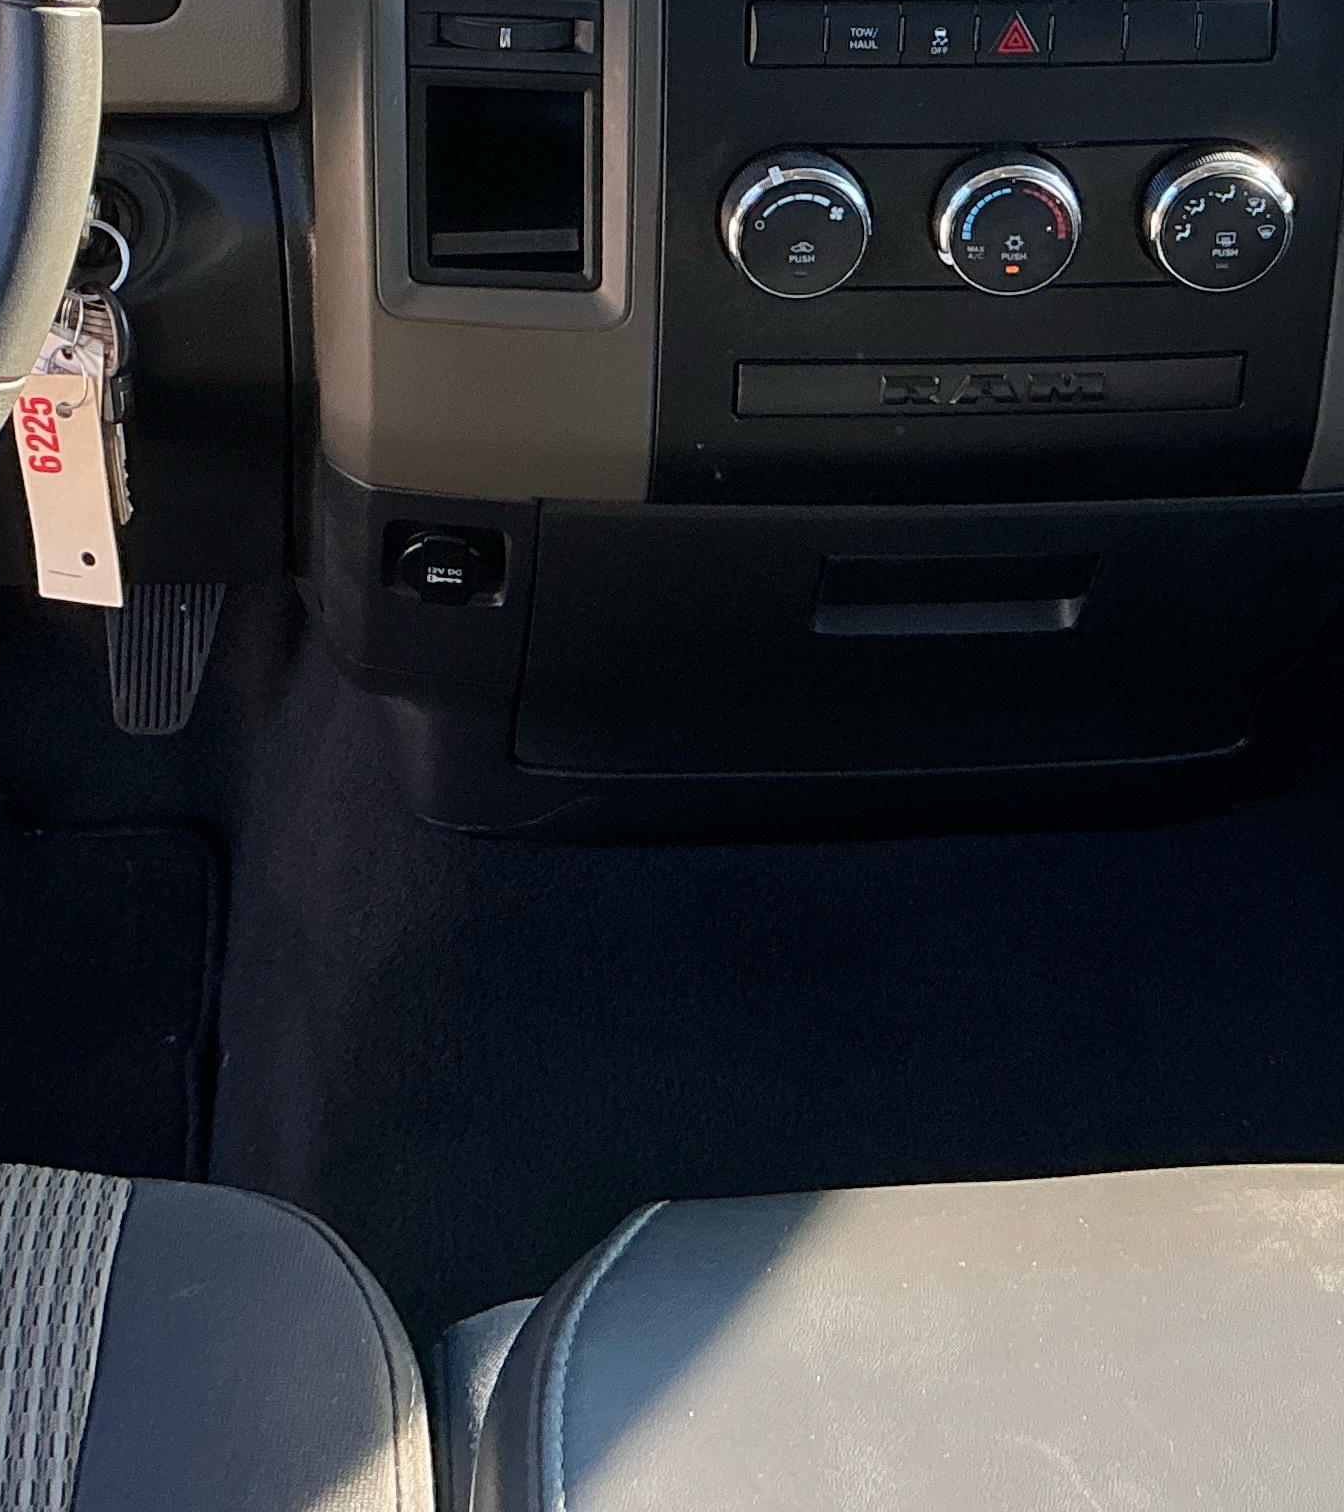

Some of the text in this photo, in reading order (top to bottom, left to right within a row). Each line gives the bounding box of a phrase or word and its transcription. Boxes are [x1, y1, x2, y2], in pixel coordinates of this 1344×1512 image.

[850, 27, 879, 38] TOW/
[849, 39, 878, 49] HAUL
[930, 46, 949, 55] OFF
[966, 245, 985, 253] MAX
[1211, 248, 1238, 258] PUSH
[788, 254, 815, 264] PUSH
[967, 252, 984, 261] A/C
[1000, 252, 1028, 262] PUSH
[879, 371, 1106, 406] RAM
[19, 396, 62, 474] 6225
